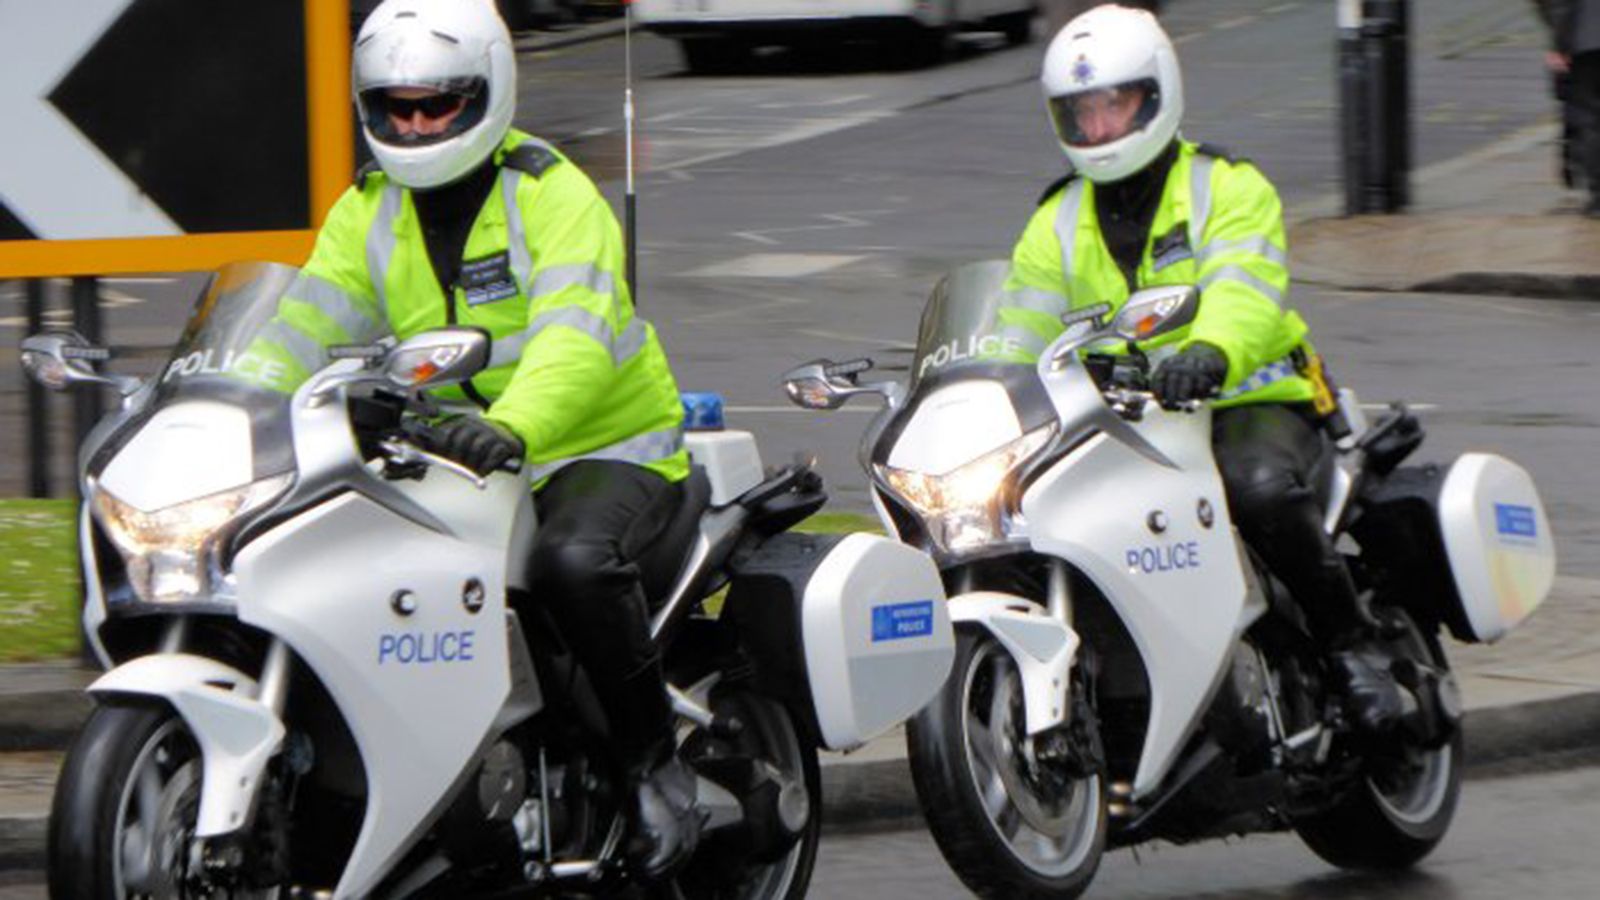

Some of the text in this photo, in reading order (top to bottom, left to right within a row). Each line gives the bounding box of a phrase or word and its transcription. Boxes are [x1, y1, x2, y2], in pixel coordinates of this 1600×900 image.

[163, 348, 287, 388] POLICE
[919, 335, 1020, 378] POLICE
[1126, 541, 1199, 573] POLICE
[378, 629, 475, 665] POLICE
